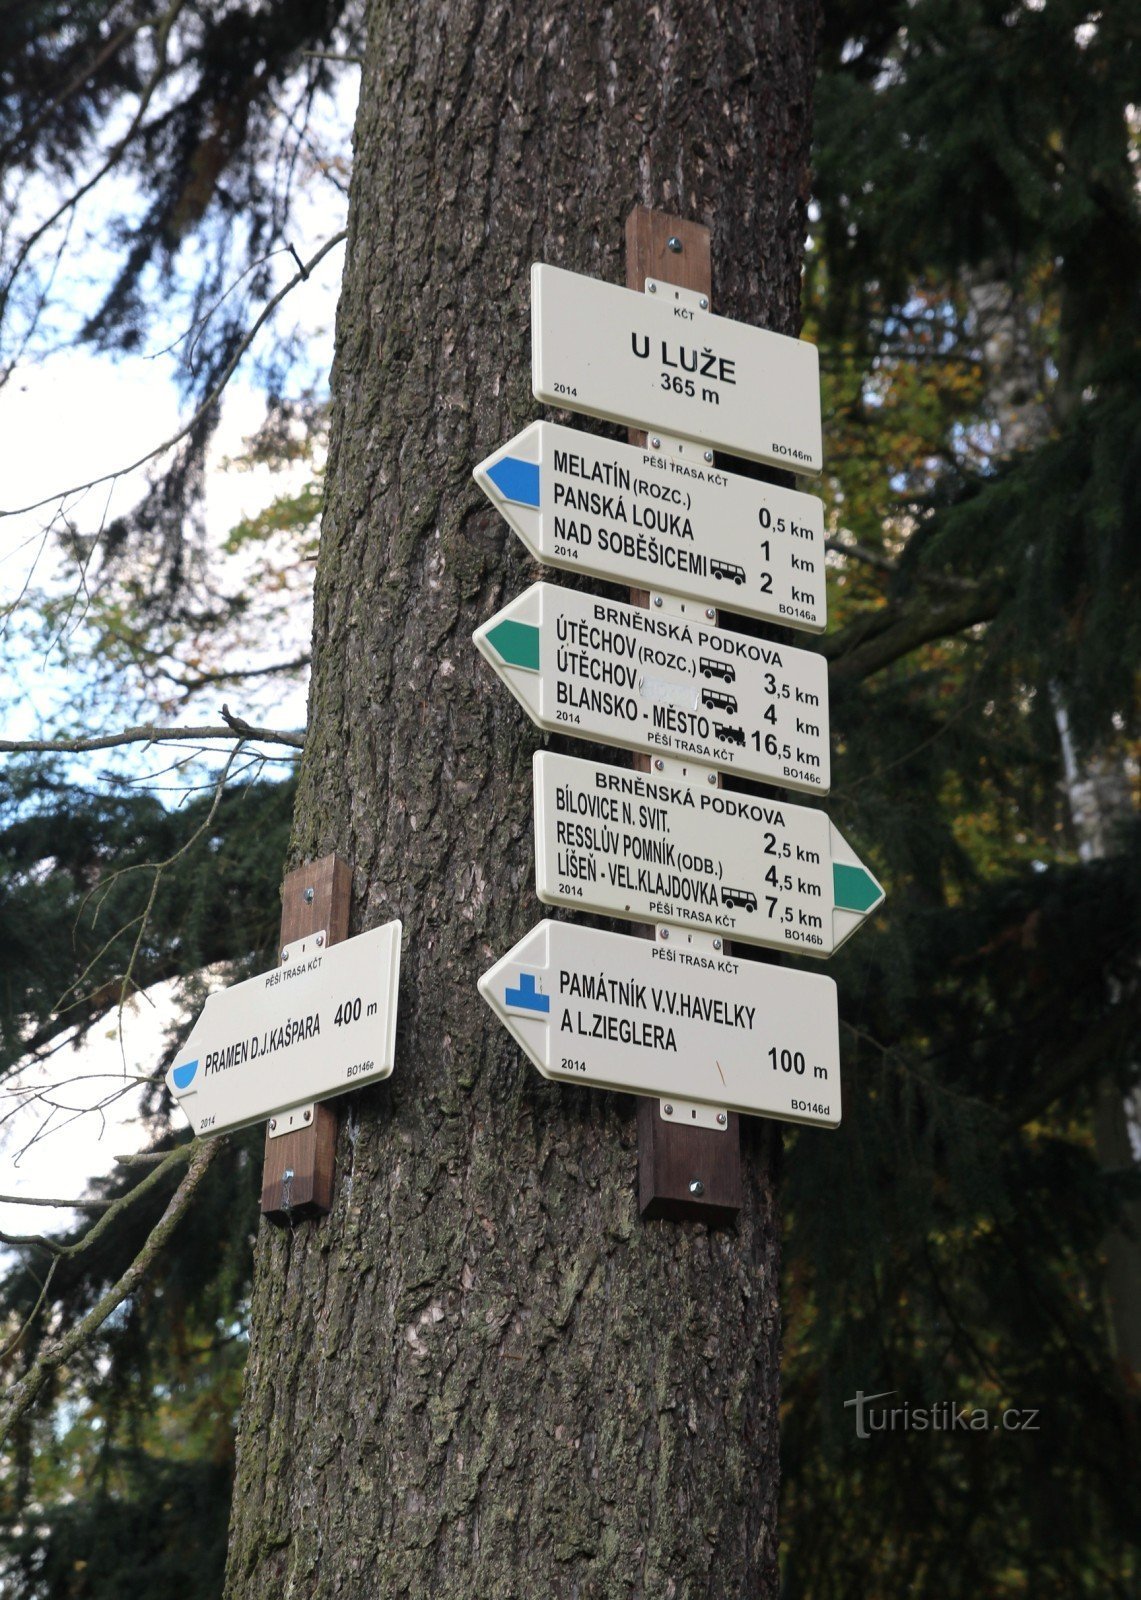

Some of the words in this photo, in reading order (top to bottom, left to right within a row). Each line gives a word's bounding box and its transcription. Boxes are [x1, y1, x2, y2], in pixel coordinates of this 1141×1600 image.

[674, 307, 694, 321] KČT
[631, 332, 650, 358] U
[661, 341, 736, 384] LUŽE
[554, 383, 578, 397] 2014
[660, 373, 695, 397] 365
[702, 387, 720, 404] m
[772, 444, 812, 462] BO146m
[643, 455, 667, 470] PĚŠÍ
[670, 462, 705, 482] TRASA
[707, 472, 728, 487] KČT
[554, 450, 630, 490] MELATÍN
[633, 478, 691, 510] (ROZC.)
[791, 521, 814, 540] km
[554, 483, 627, 522] PANSKÁ
[633, 504, 694, 540] LOUKA
[760, 540, 770, 561] 1
[792, 554, 814, 572] km
[554, 545, 578, 559] 2014
[554, 517, 592, 546] NAD
[598, 528, 707, 576] SOBĚŠICEMI
[760, 572, 773, 594] 2
[792, 587, 814, 605] km
[779, 604, 816, 622] BO146a
[594, 604, 693, 644] BRNĚNSKÁ
[698, 632, 783, 668] PODKOVA
[556, 614, 636, 658] ÚTĚCHOV
[639, 646, 696, 678] (ROZC.)
[796, 688, 819, 706] km
[556, 645, 637, 690] ÚTĚCHOV
[763, 704, 777, 725] 4
[796, 718, 820, 737] km
[556, 710, 580, 724] 2014
[557, 681, 638, 721] BLANSKO
[653, 705, 710, 738] MĚSTO
[796, 748, 820, 767] km
[648, 732, 672, 747] PĚŠÍ
[675, 738, 710, 757] TRASA
[713, 748, 734, 762] KČT
[783, 767, 821, 784] BO146c
[595, 772, 695, 808] BRNĚNSKÁ
[700, 795, 785, 827] PODKOVA
[556, 785, 618, 822] BÍLOVICE
[623, 802, 635, 825] N.
[639, 805, 670, 833] SVIT.
[796, 845, 820, 864] km
[557, 821, 619, 855] RESSLŮV
[624, 835, 675, 866] POMNÍK
[677, 853, 722, 880] (ODB.)
[798, 877, 821, 897] km
[558, 849, 596, 882] LÍŠEŇ
[799, 909, 822, 928] km
[559, 884, 583, 897] 2014
[649, 902, 674, 916] PĚŠÍ
[676, 907, 712, 924] TRASA
[715, 915, 736, 928] KČT
[784, 929, 823, 945] BO146b
[265, 974, 281, 988] PĚŠÍ
[283, 964, 306, 981] TRASA
[307, 958, 322, 972] KČT
[652, 948, 676, 962] PĚŠÍ
[679, 954, 715, 971] TRASA
[718, 962, 738, 974] KČT
[560, 971, 647, 1010] PAMÁTNÍK
[205, 1040, 248, 1076] PRAMEN
[334, 998, 361, 1027] 400
[367, 1002, 377, 1017] m
[561, 1009, 573, 1033] A
[768, 1047, 805, 1075] 100
[814, 1065, 828, 1080] m
[347, 1061, 374, 1077] BO146e
[561, 1059, 586, 1072] 2014
[201, 1116, 215, 1128] 2014
[791, 1099, 830, 1116] BO146d
